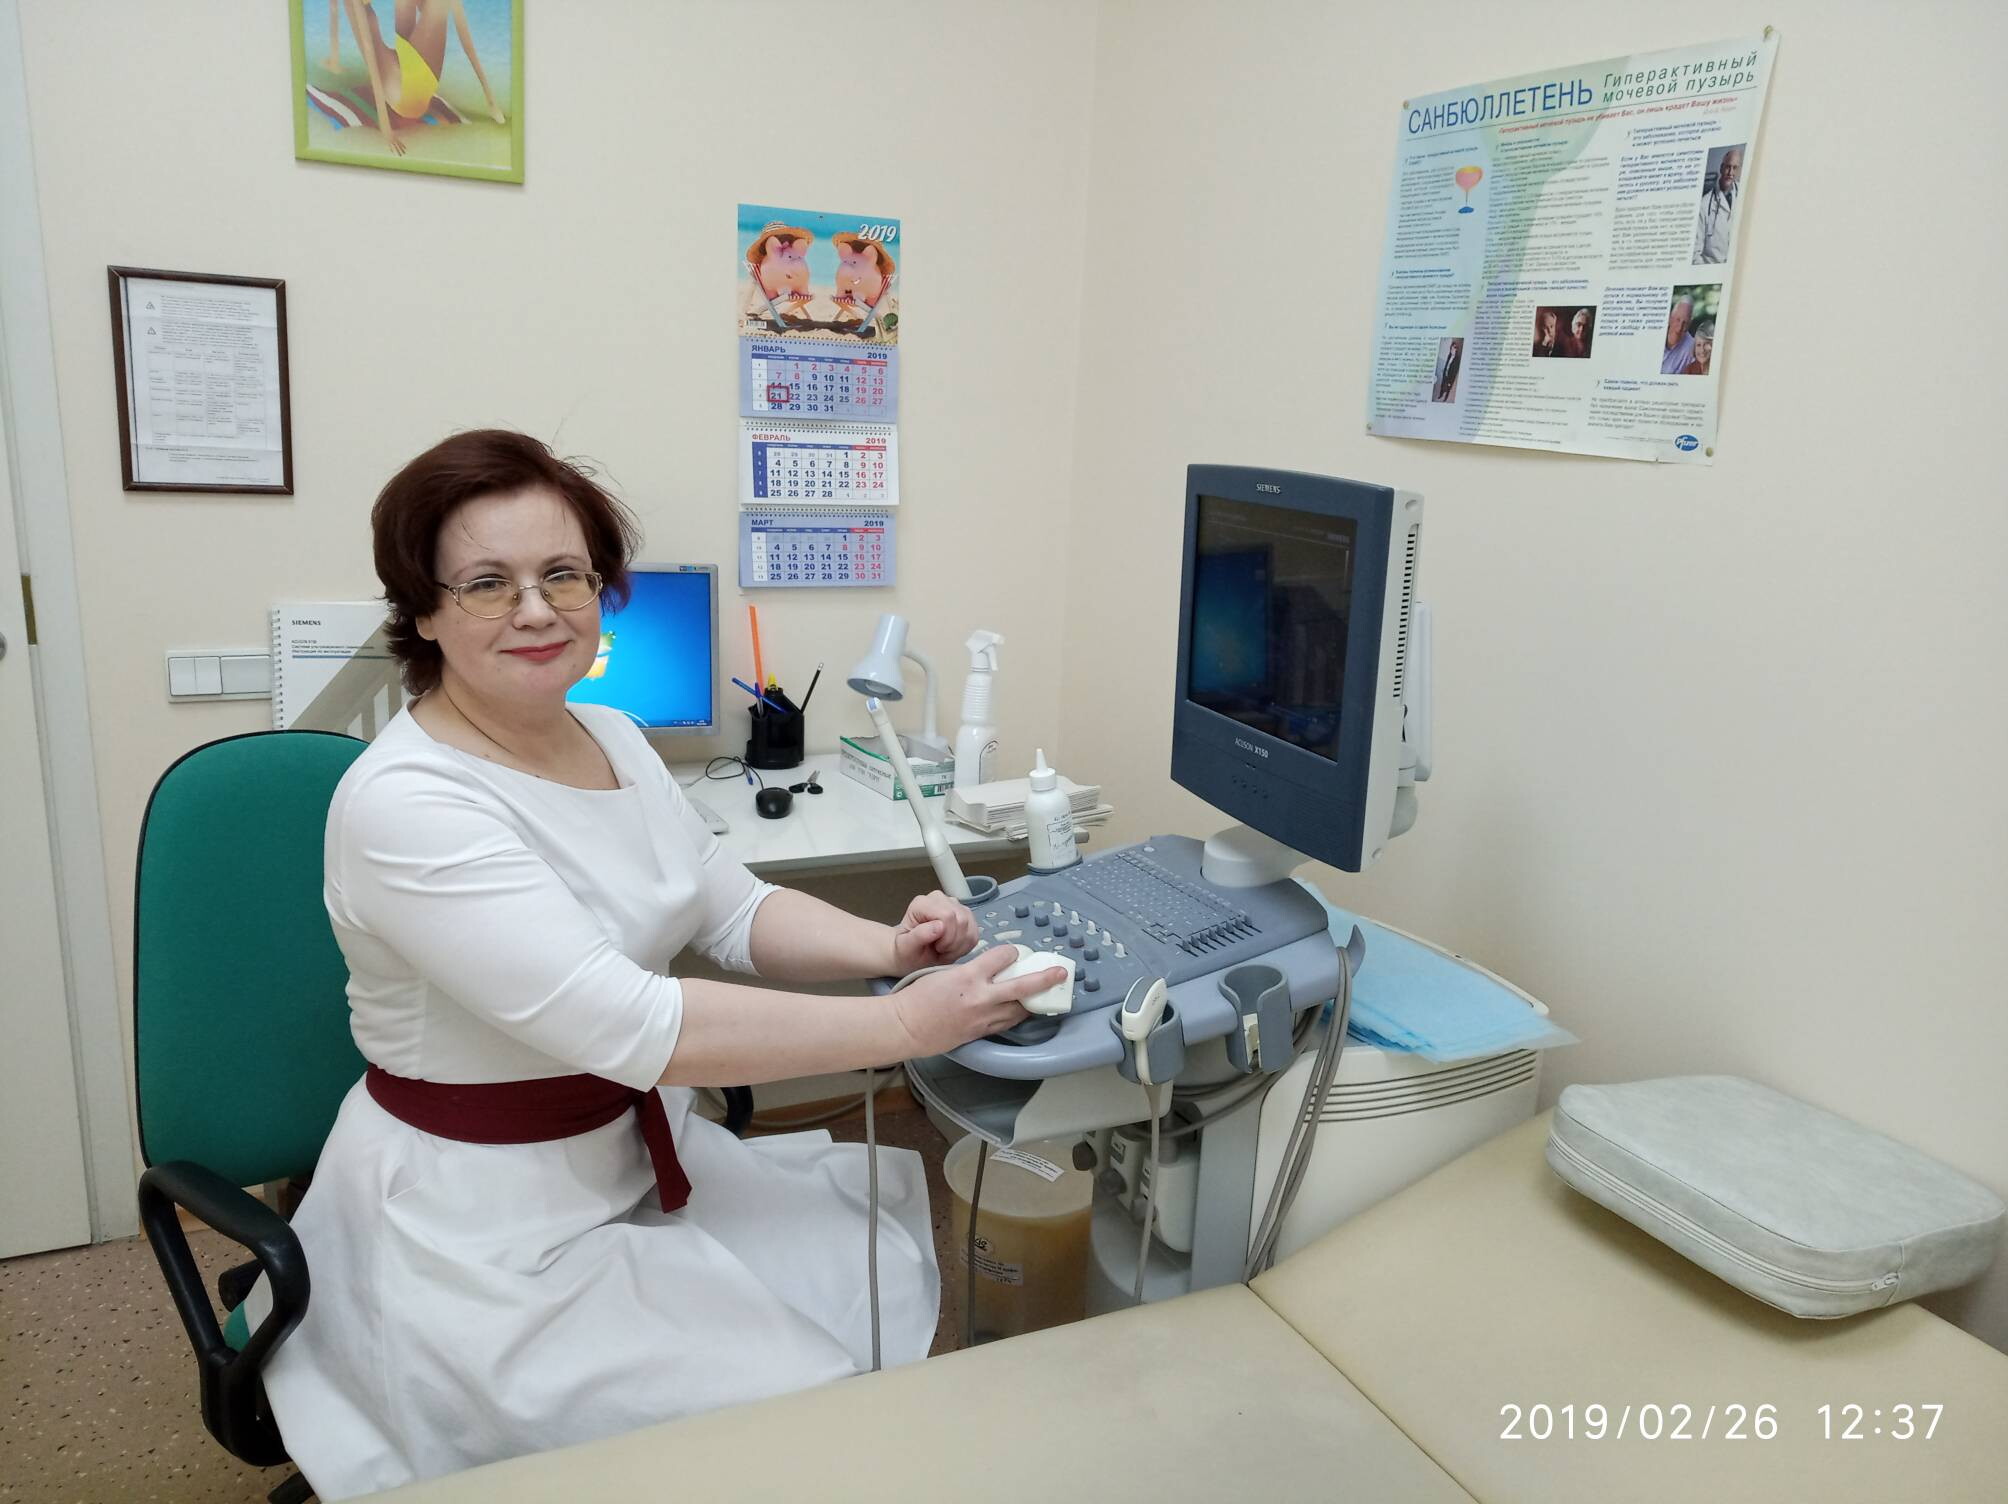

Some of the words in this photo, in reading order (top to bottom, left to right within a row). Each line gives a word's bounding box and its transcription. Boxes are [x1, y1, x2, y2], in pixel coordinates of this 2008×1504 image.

[1603, 50, 1758, 88] Гиперактивный
[1602, 79, 1677, 103] мочевой
[1685, 71, 1754, 93] пузырь
[1408, 79, 1593, 134] САНБЮЛЛЕТЕНЬ
[858, 223, 897, 242] 2019
[751, 344, 786, 353] ЯНВАРЬ
[812, 363, 817, 371] 2
[828, 364, 834, 372] 3
[812, 373, 817, 381] 9
[824, 374, 834, 382] 10
[824, 384, 834, 392] 17
[770, 392, 782, 400] 21
[789, 393, 801, 401] 22
[872, 397, 883, 405] 27
[789, 403, 800, 411] 29
[824, 404, 834, 412] 31
[752, 434, 791, 442] ФЕВРАЛЬ
[805, 470, 815, 478] 13
[1256, 483, 1280, 494] SIEMENS
[1254, 745, 1269, 758] X150
